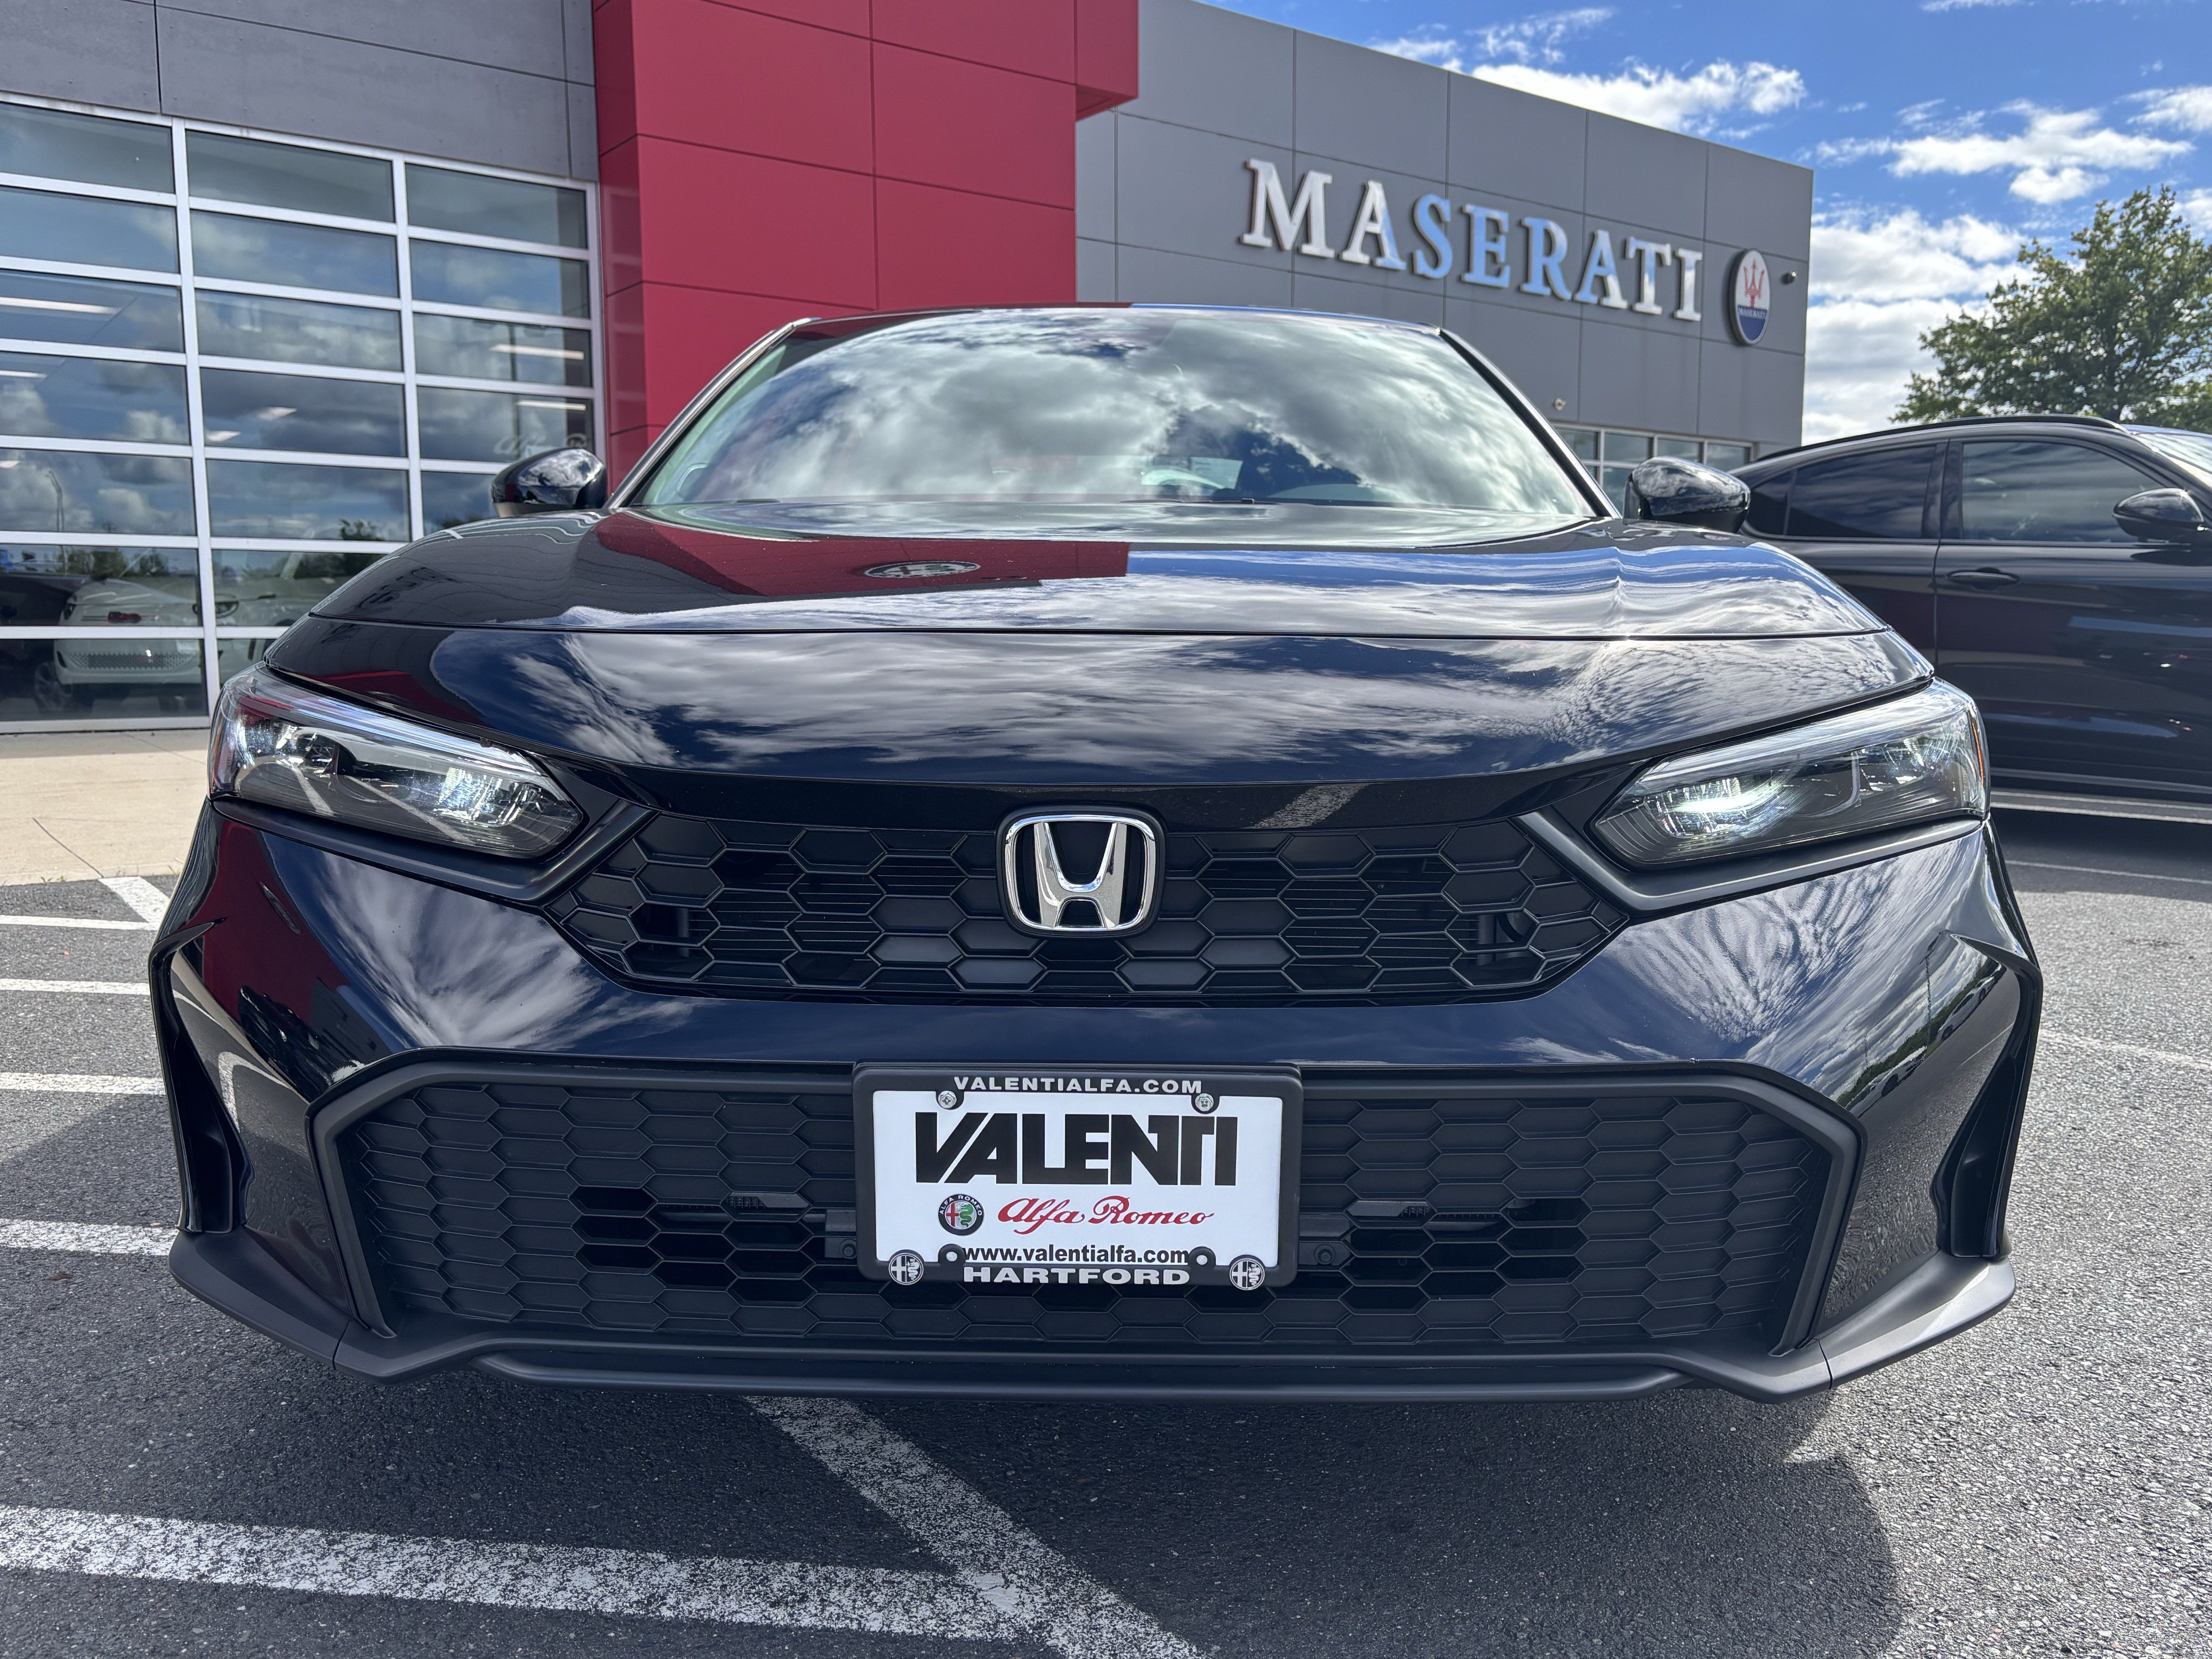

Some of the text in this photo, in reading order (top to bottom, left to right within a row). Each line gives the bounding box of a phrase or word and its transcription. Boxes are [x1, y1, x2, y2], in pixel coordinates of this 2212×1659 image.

[1240, 158, 1703, 321] MASERATI
[954, 1077, 1202, 1094] VALENTIALFA.COM
[915, 1112, 1238, 1186] VALENTI
[940, 1195, 982, 1216] ALFA ROMEO
[998, 1195, 1214, 1235] Alfa Romeo
[962, 1244, 1188, 1264] www.valentialfa.com
[964, 1266, 1190, 1285] HARTFORD
